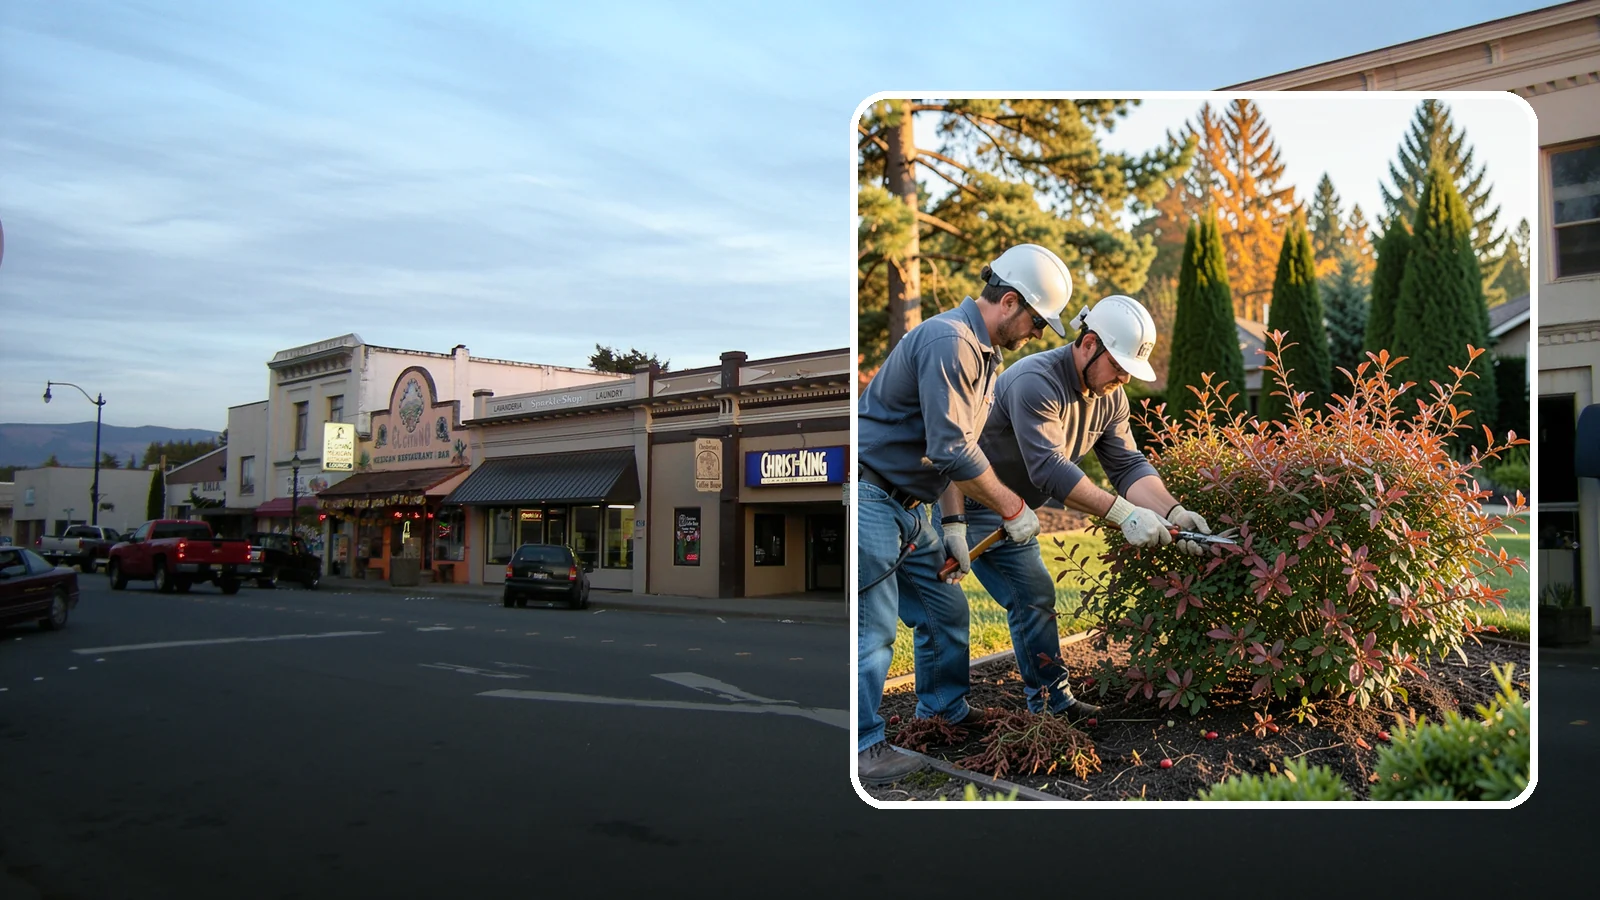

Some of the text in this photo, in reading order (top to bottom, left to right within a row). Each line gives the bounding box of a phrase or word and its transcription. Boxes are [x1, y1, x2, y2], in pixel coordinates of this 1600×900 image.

[561, 394, 582, 404] Shop
[595, 389, 623, 400] LAUNDRY
[493, 402, 522, 412] LAVANDERIA
[373, 450, 450, 464] MEXICAN RESTAURANT BAR
[760, 450, 827, 478] CHRIST KING
